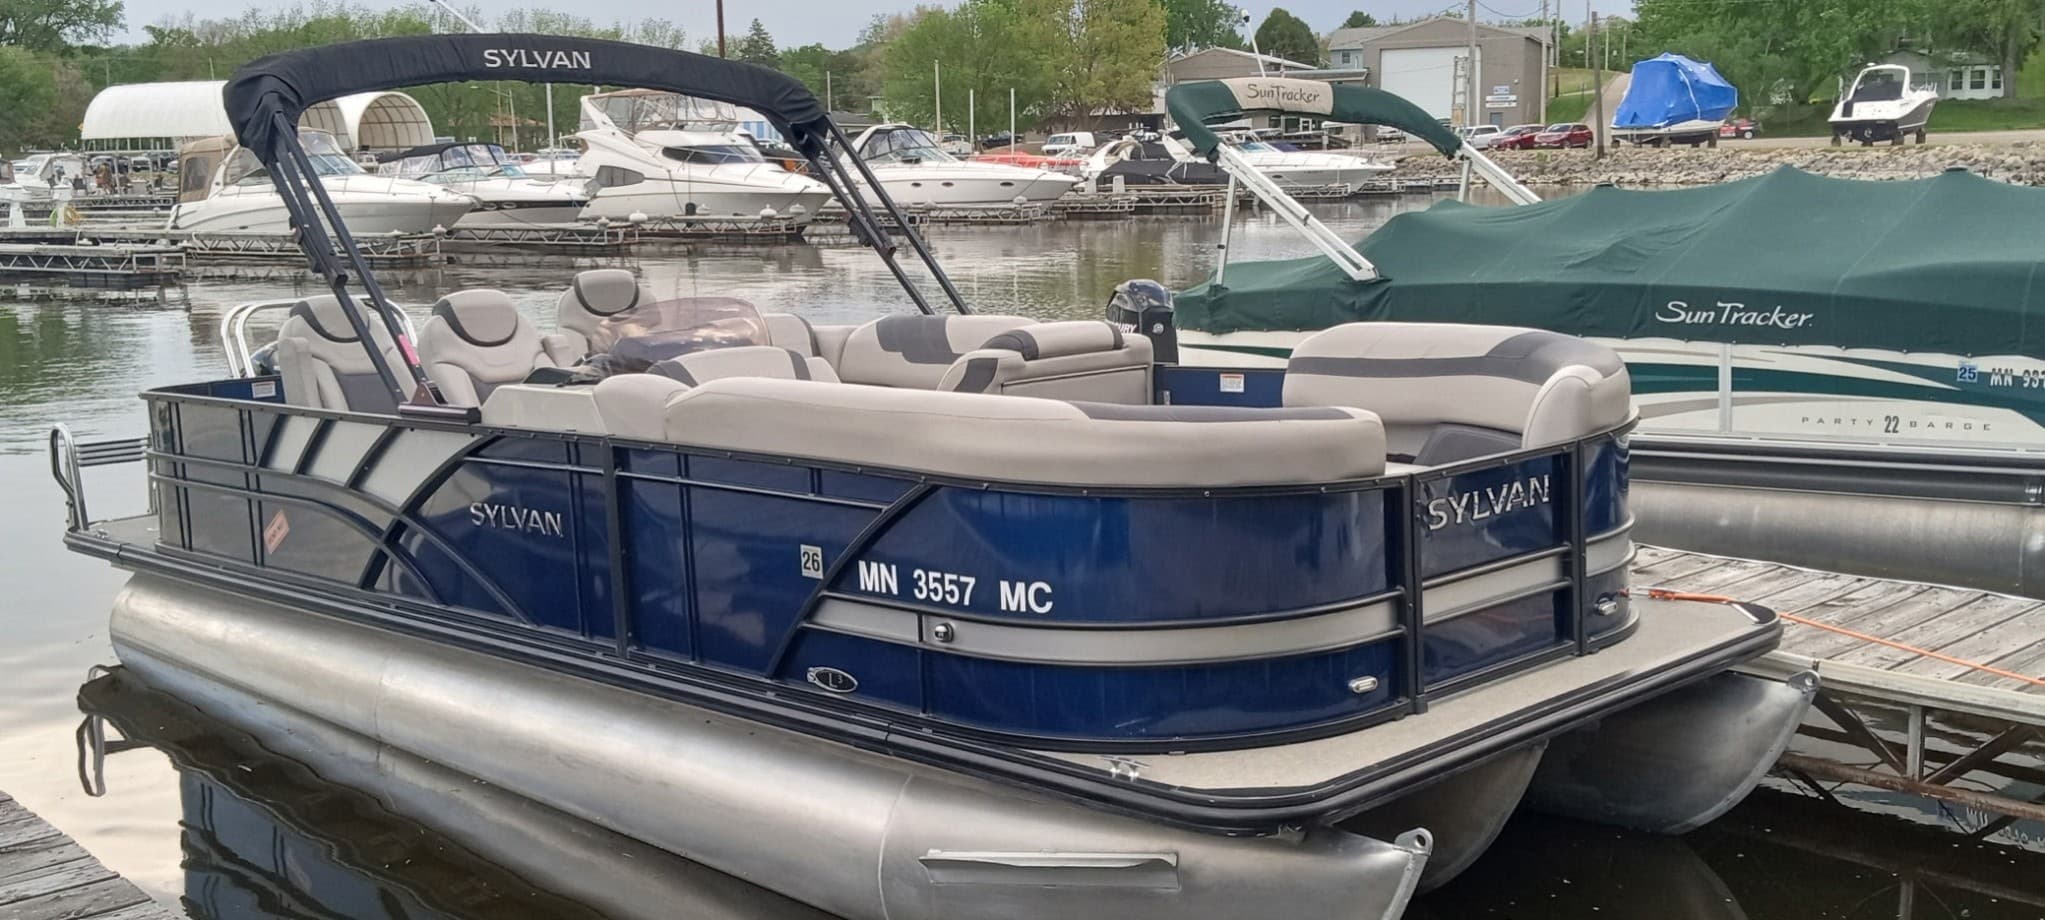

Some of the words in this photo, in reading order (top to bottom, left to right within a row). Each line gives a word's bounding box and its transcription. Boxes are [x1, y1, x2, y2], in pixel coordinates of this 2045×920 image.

[483, 49, 592, 69] SYLVAN
[1959, 366, 1976, 380] 25
[1990, 367, 2013, 387] MN
[1801, 416, 1873, 426] PARTY
[1884, 415, 1900, 434] 22
[1909, 420, 1991, 431] BARGE
[1428, 474, 1549, 530] SYLVAN
[470, 502, 564, 538] SYLVAN
[803, 551, 820, 572] 26
[858, 560, 899, 595] MN
[913, 569, 976, 606] 3557
[1000, 580, 1053, 614] MC
